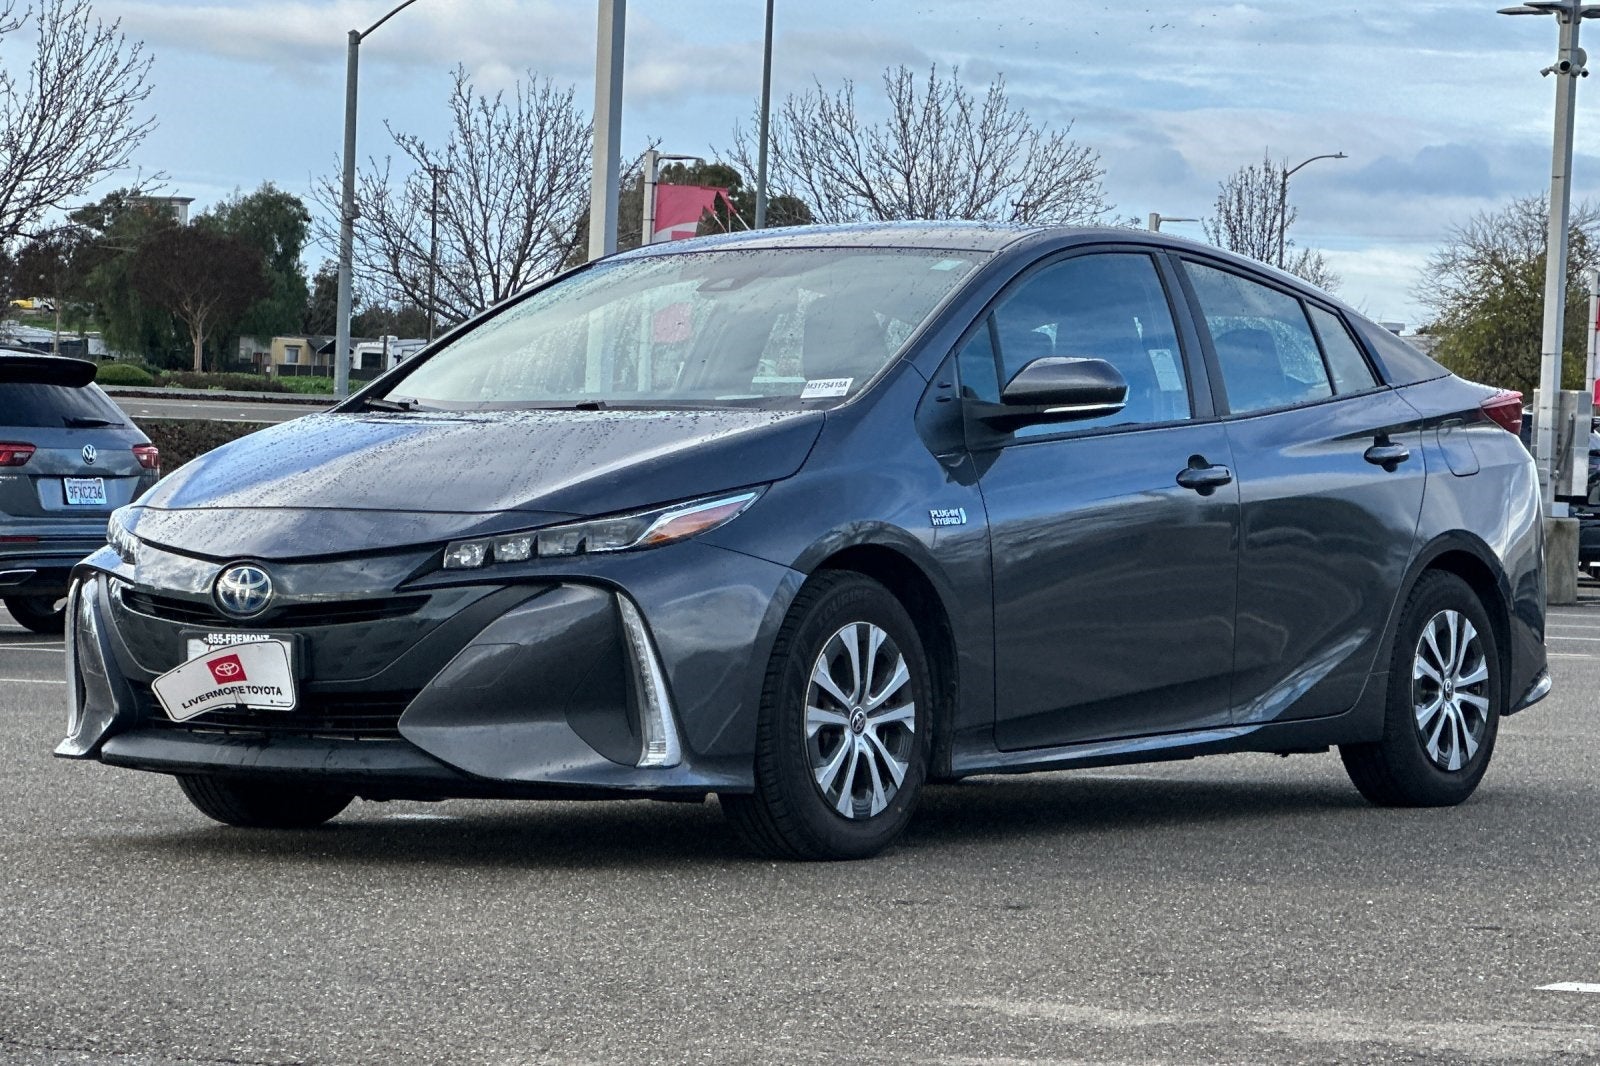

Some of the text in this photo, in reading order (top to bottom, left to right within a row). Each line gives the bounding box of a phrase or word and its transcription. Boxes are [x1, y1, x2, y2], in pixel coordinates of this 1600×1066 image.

[805, 381, 848, 390] M3175415A
[68, 486, 103, 499] 9FXC236
[930, 508, 960, 518] PLUG-IN
[931, 517, 961, 526] HYBRID
[181, 685, 283, 709] LIVERMORE TOYOTA
